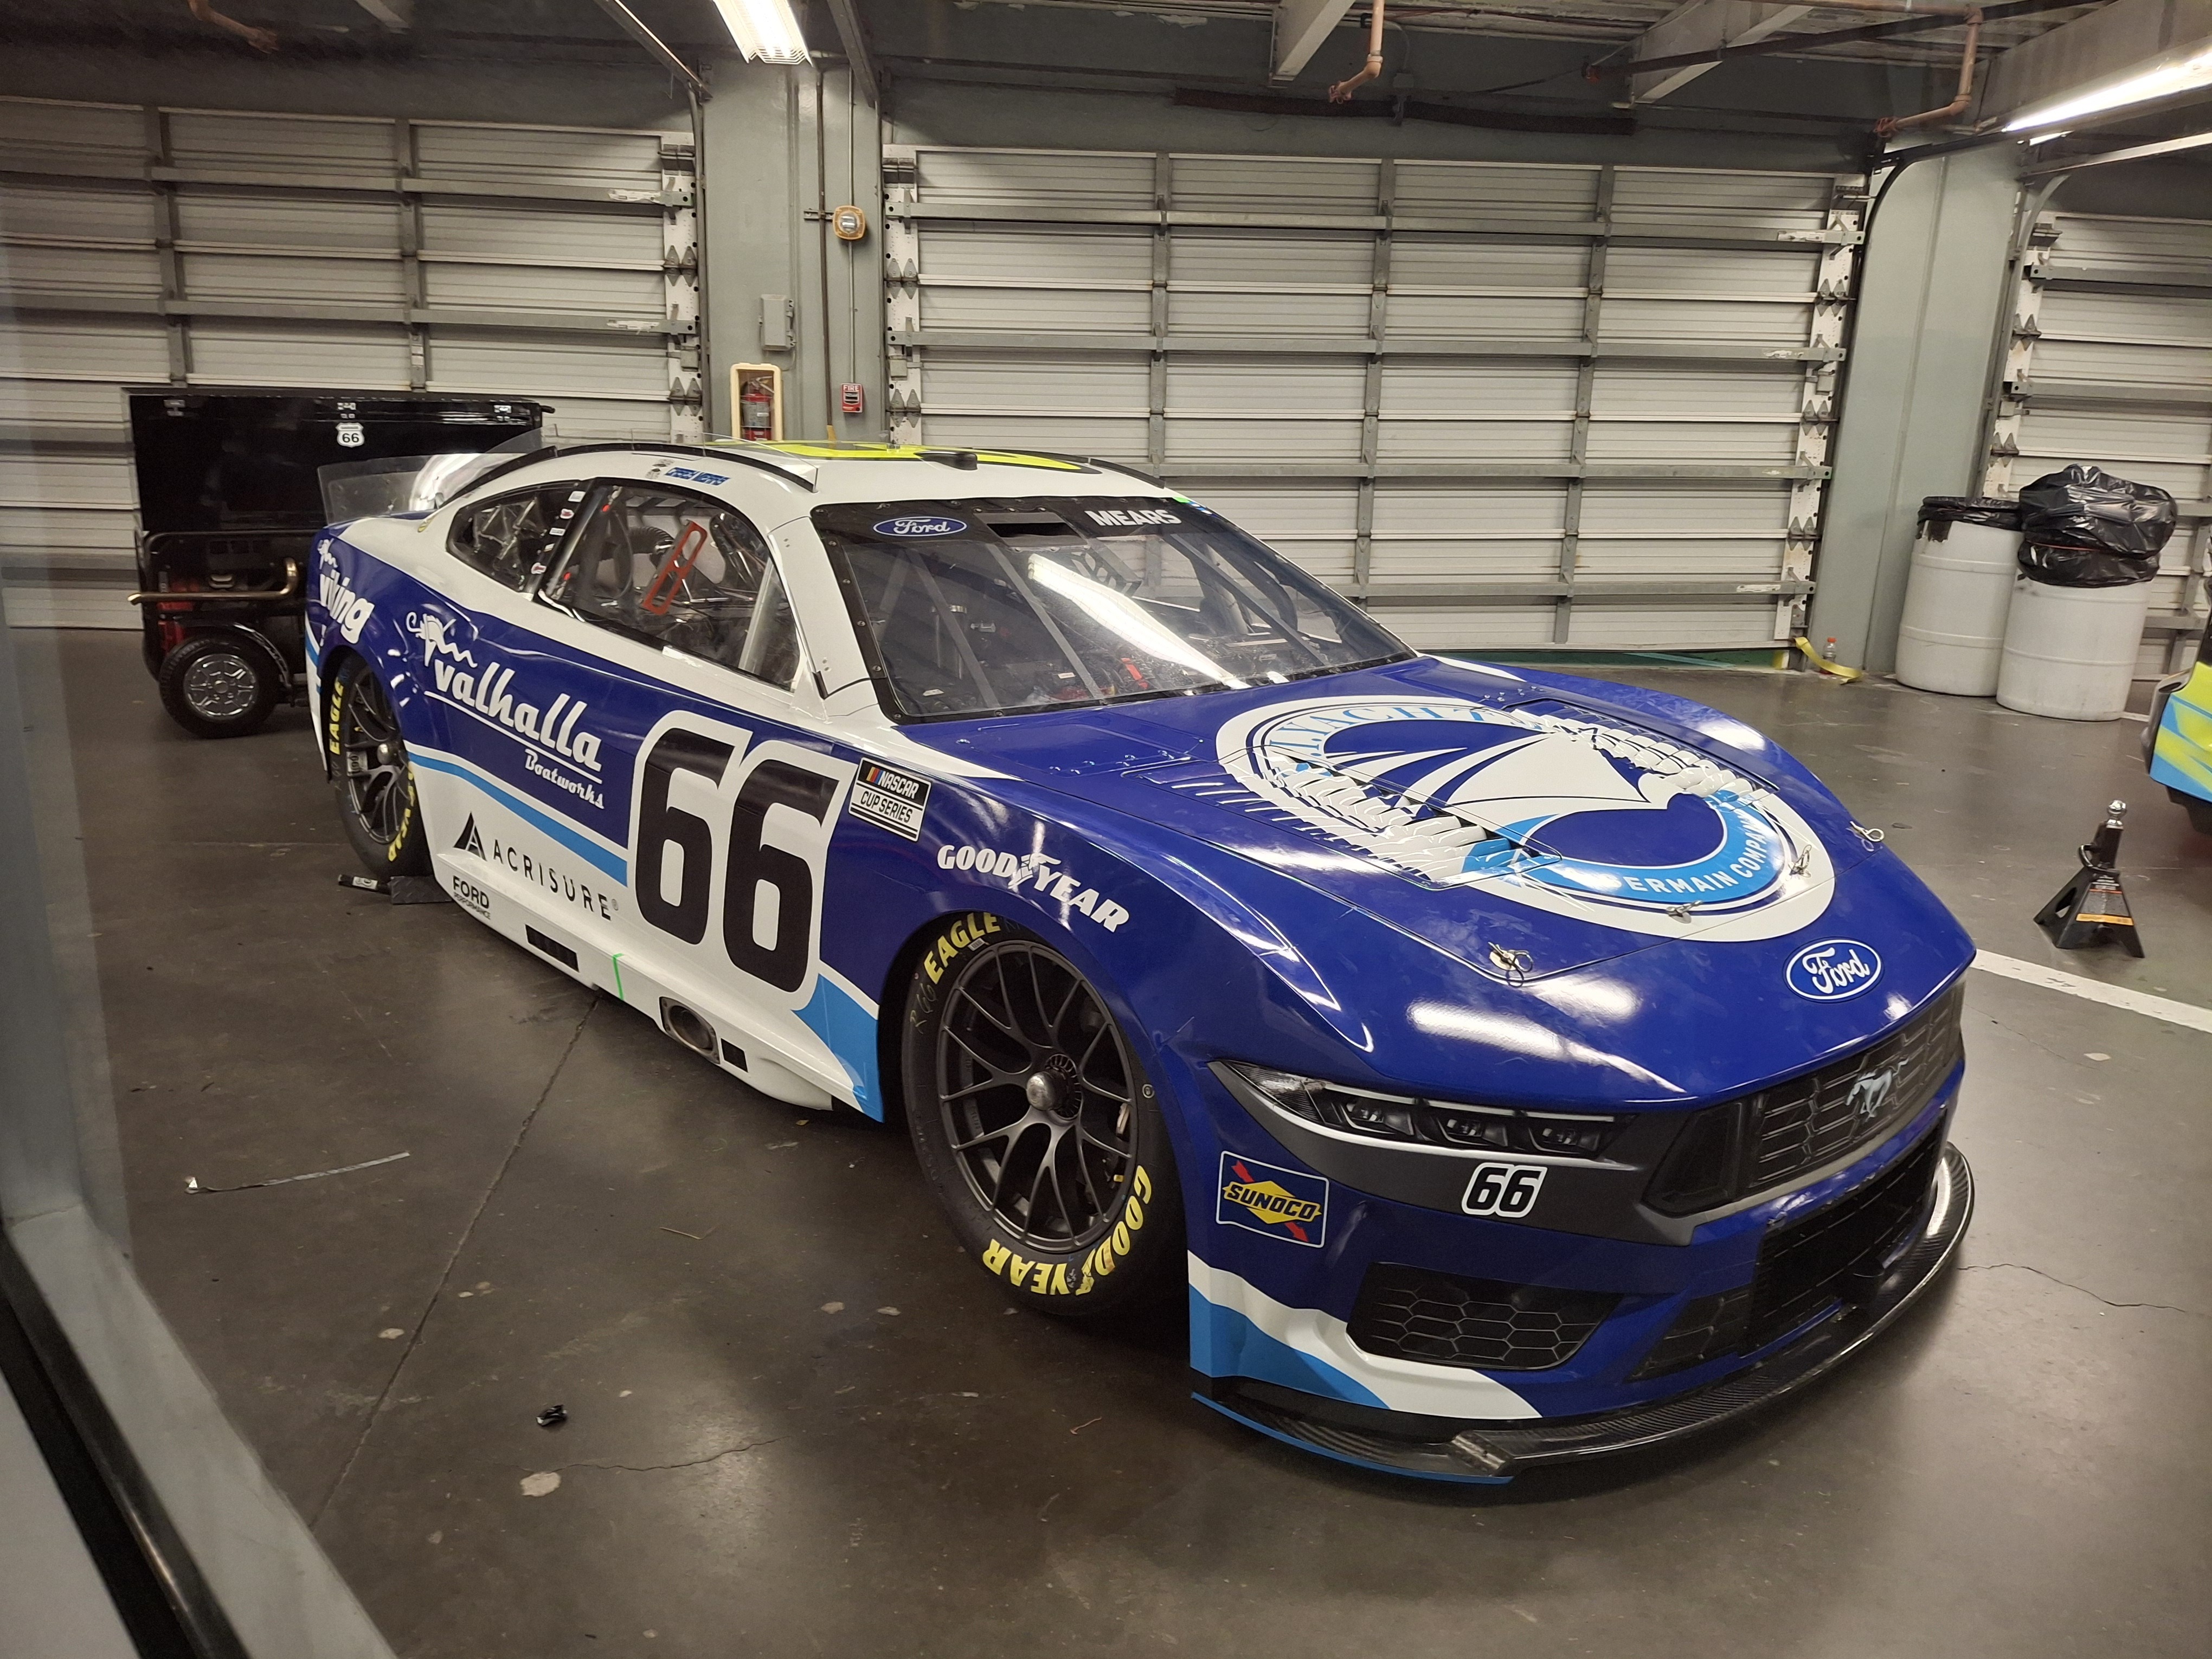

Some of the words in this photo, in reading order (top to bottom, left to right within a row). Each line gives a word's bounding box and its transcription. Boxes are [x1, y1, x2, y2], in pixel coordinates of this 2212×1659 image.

[342, 433, 359, 443] 66
[893, 518, 951, 535] Ford
[1085, 509, 1182, 528] MEARS
[320, 569, 375, 644] viking
[329, 676, 345, 755] EAGLE
[434, 662, 602, 772] valhalla
[525, 749, 605, 809] Boatworks
[877, 770, 920, 800] NASCAR
[860, 790, 880, 809] CUP
[878, 798, 913, 824] SERIES
[635, 728, 840, 993] 66
[1623, 871, 1739, 893] ERMAIN
[453, 875, 489, 909] FORD
[924, 912, 1001, 985] EAGLE
[1802, 947, 1870, 994] Ford
[1226, 1184, 1319, 1223] SUNOCO
[1465, 1166, 1544, 1216] 66
